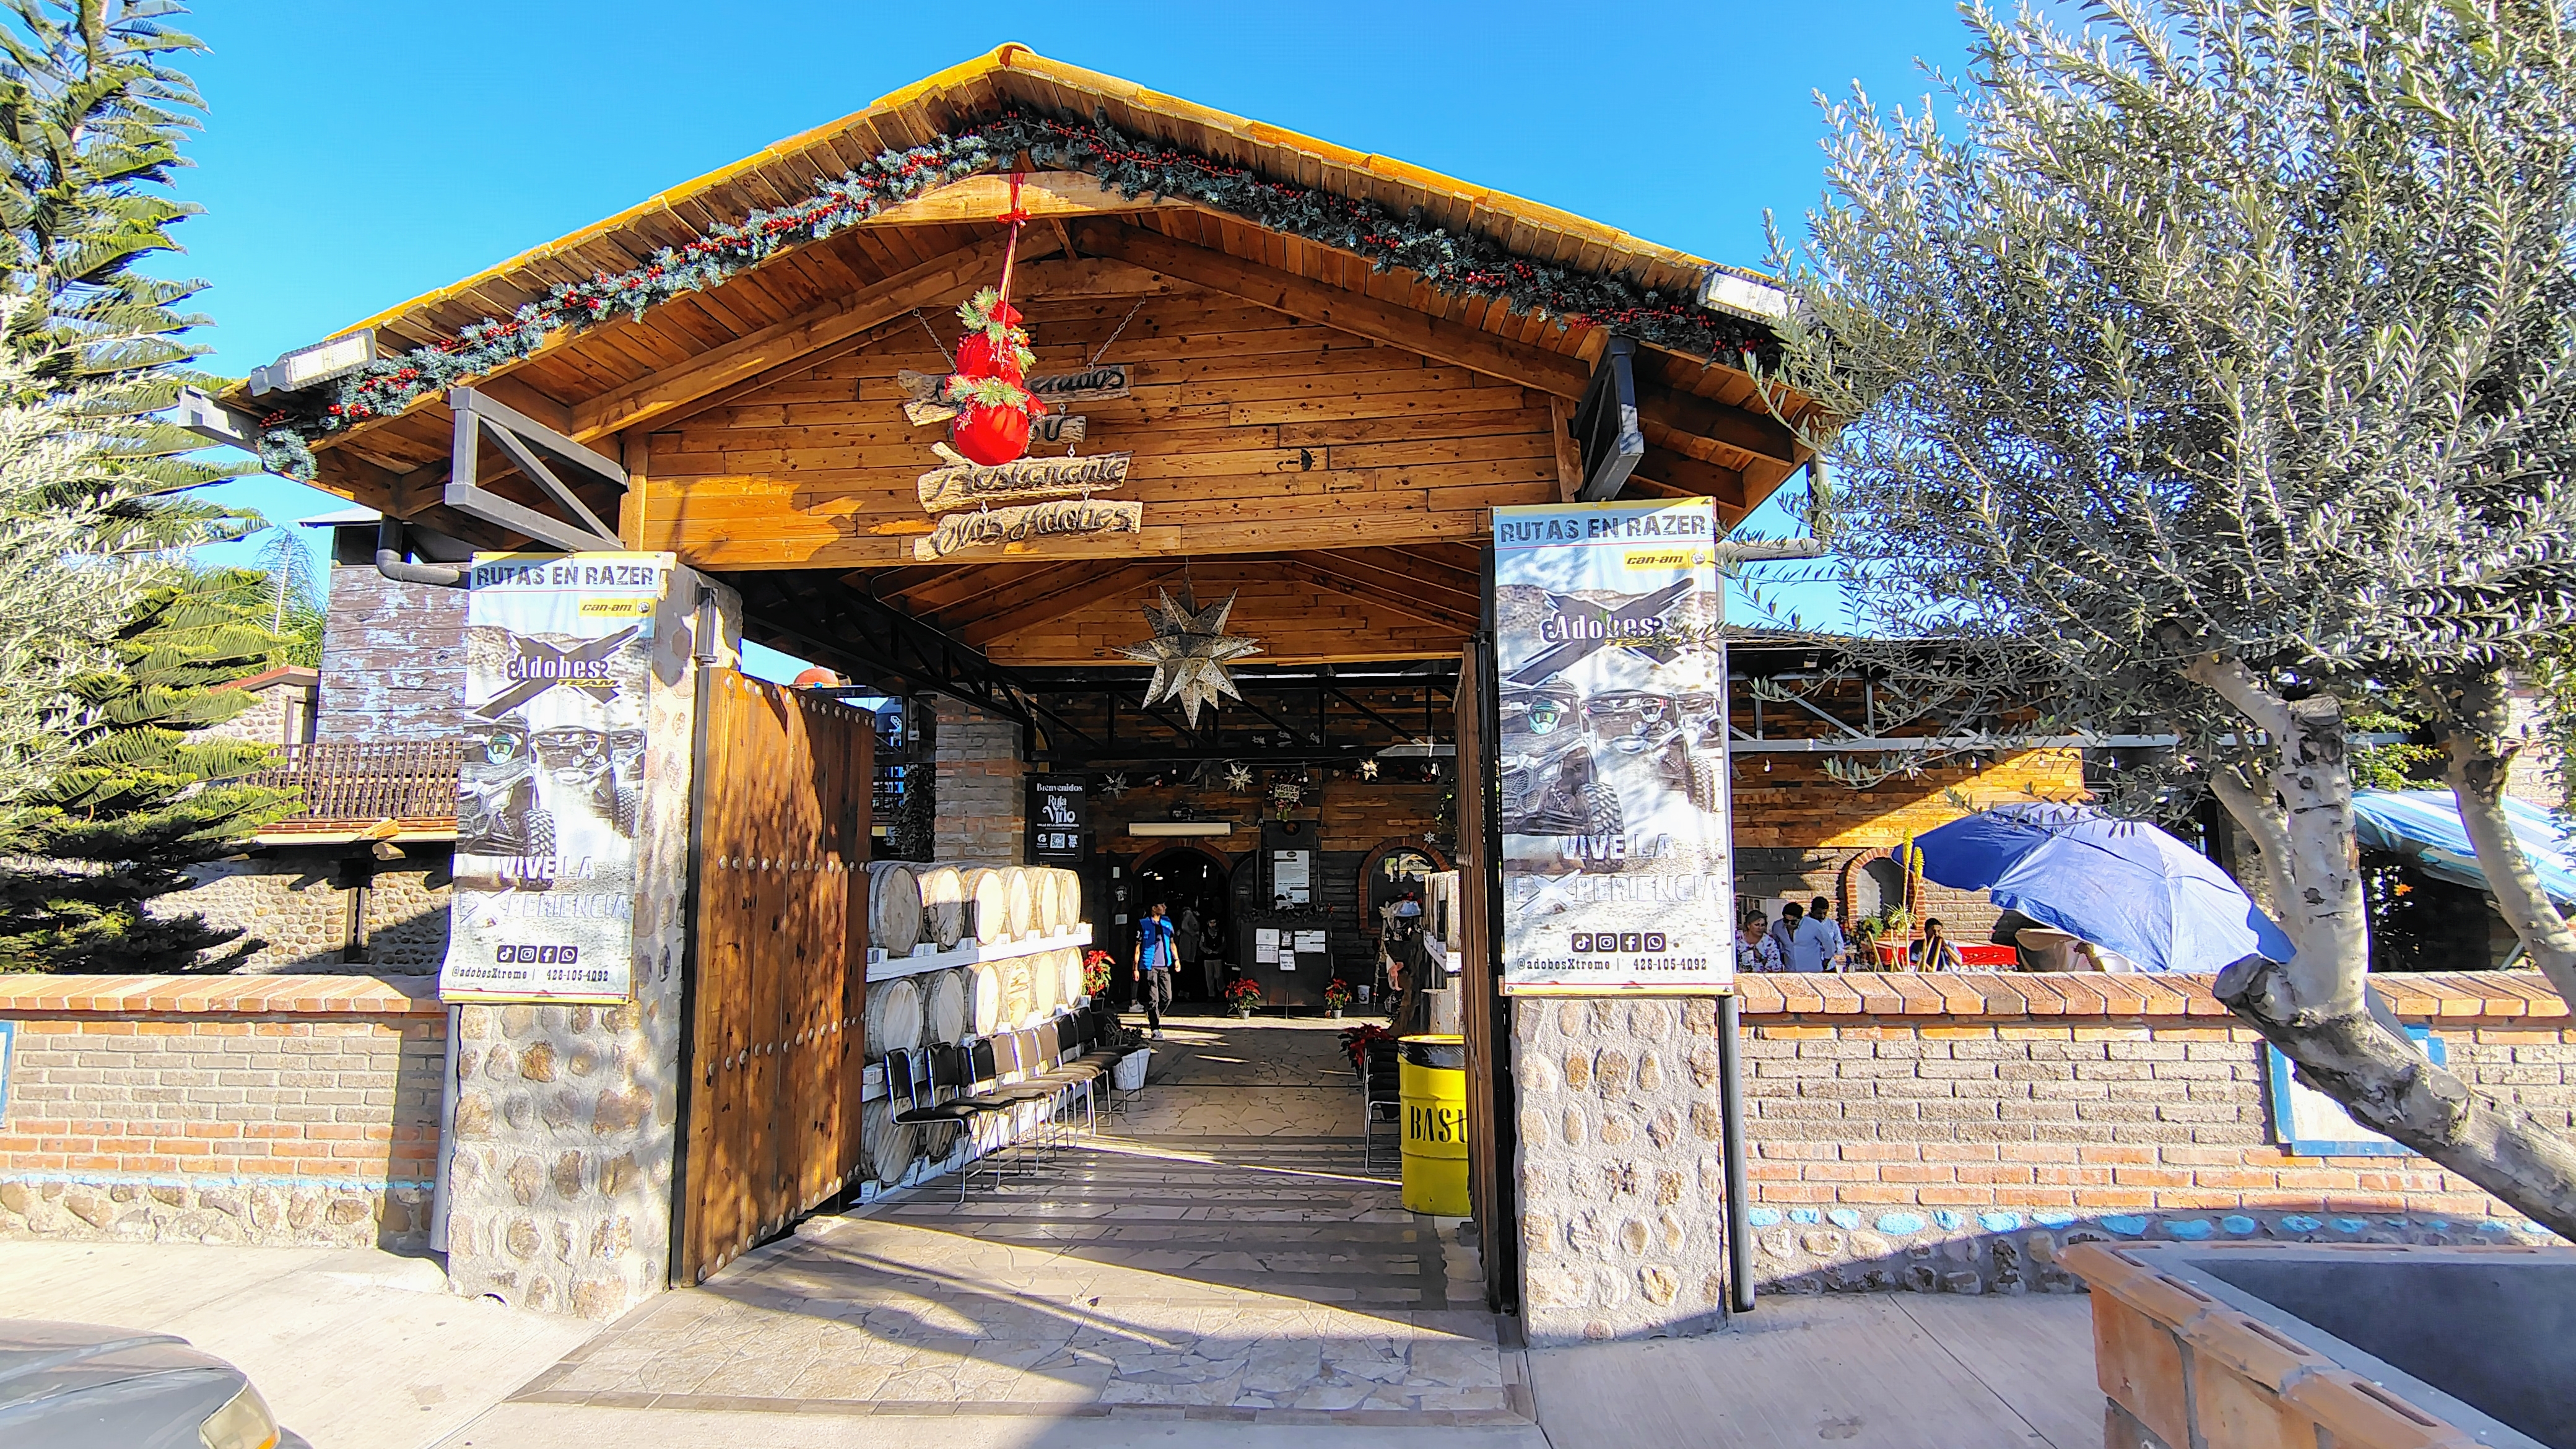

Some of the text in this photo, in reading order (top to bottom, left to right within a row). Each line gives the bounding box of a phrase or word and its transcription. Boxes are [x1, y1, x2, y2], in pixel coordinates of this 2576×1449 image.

[1500, 515, 1706, 542] RUTAS EN RAZER
[1626, 554, 1684, 565] can-am
[476, 565, 653, 586] RUTAS EN RAZER
[581, 604, 633, 612] can-am
[511, 656, 603, 679] Adobes
[1037, 783, 1083, 792] Bienvenidos
[1557, 834, 1626, 859] VIVE
[499, 856, 556, 879] VIVE
